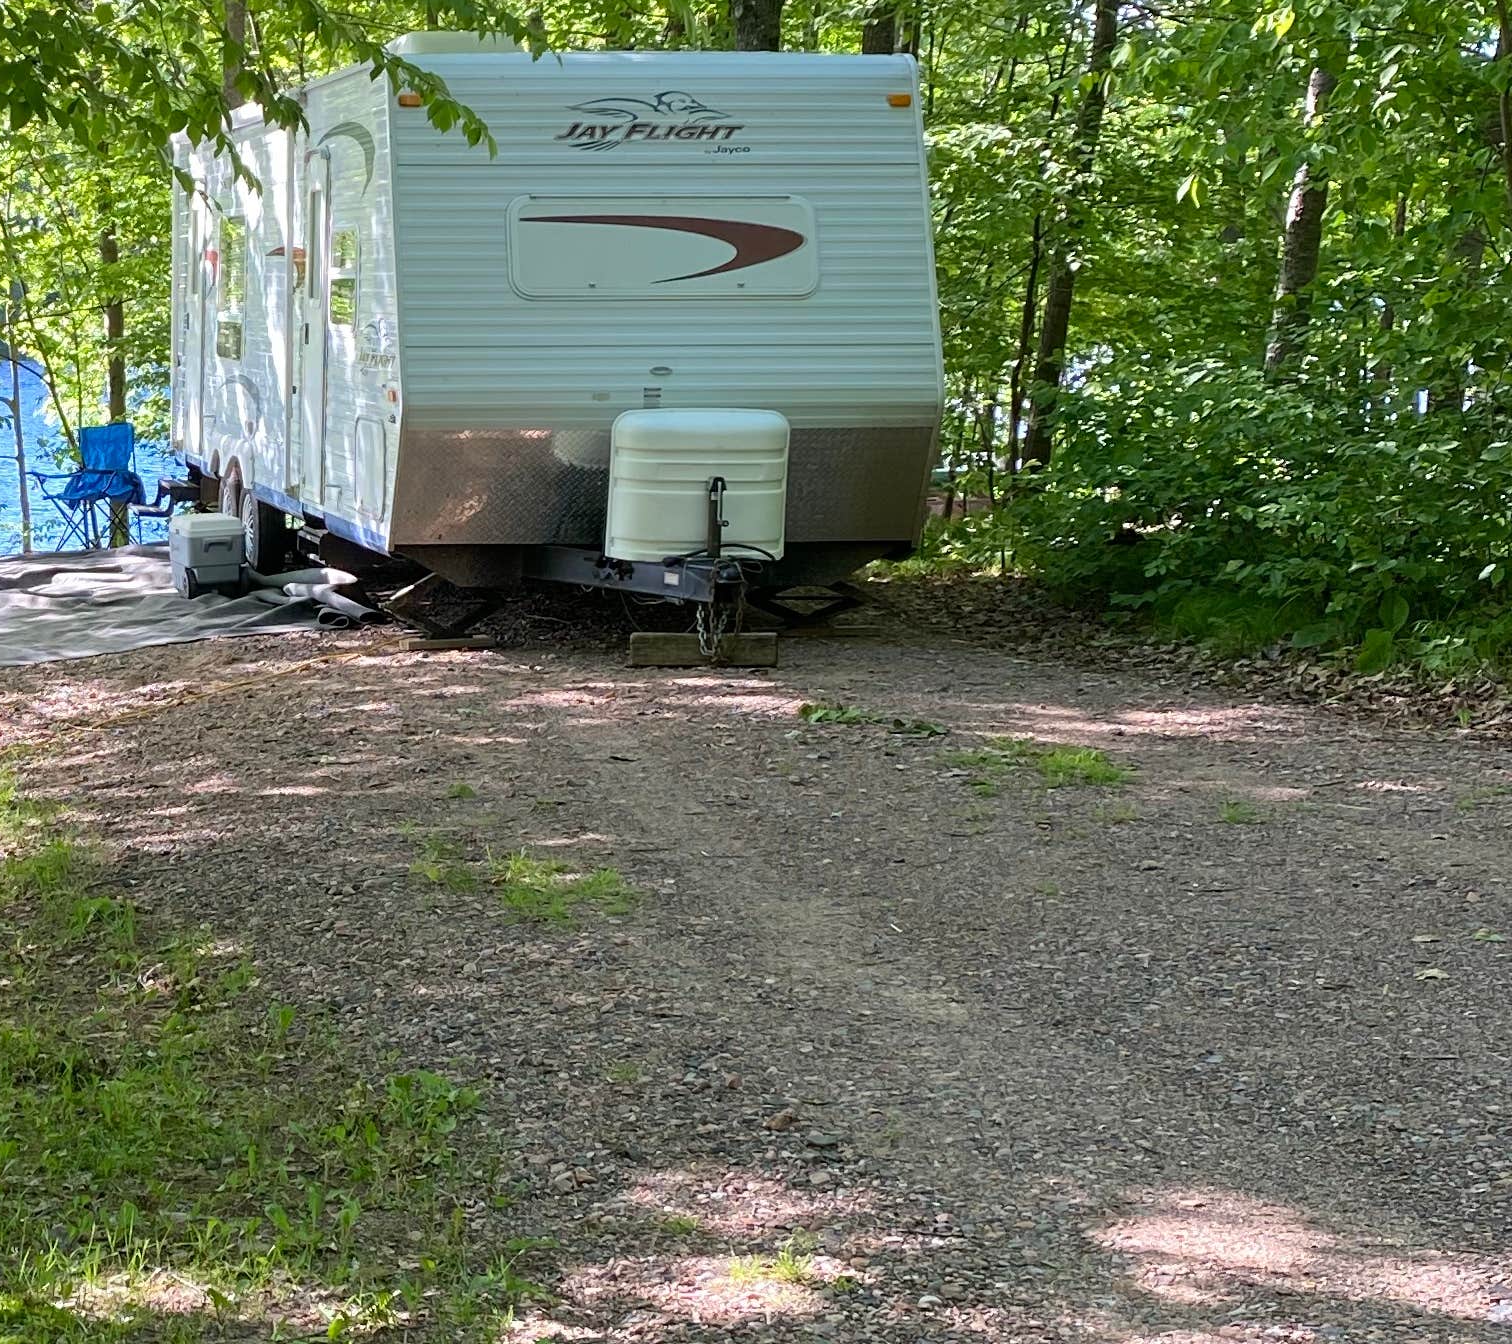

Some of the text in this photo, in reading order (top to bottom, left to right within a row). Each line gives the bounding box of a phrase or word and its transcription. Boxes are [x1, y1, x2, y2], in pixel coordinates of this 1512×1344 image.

[554, 121, 745, 141] JAY FLIGHT
[712, 145, 751, 155] Jayco
